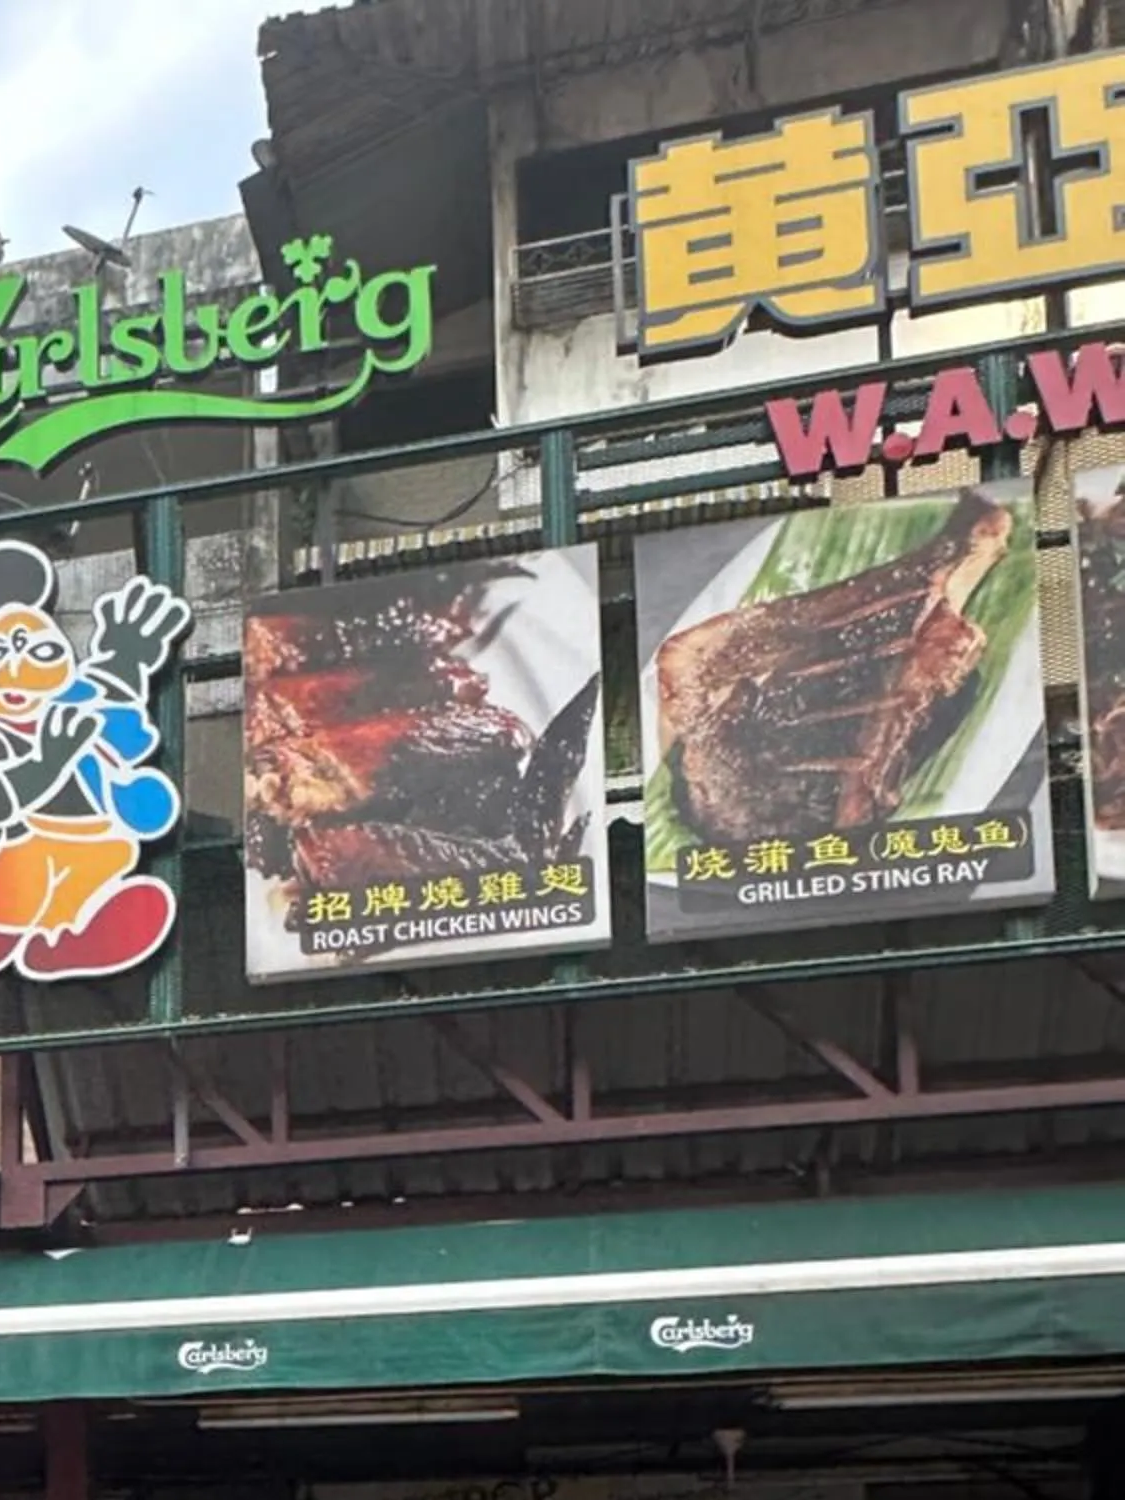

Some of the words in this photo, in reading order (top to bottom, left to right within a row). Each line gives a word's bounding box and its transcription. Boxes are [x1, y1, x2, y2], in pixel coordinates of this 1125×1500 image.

[738, 874, 846, 904] GRILLED
[851, 865, 931, 893] STING
[937, 858, 988, 884] RAY
[313, 924, 389, 950] ROAST
[394, 911, 496, 941] CHICKEN
[500, 902, 583, 929] WINGS
[650, 1315, 754, 1353] Carlsberg
[178, 1339, 267, 1374] Carlsberg
